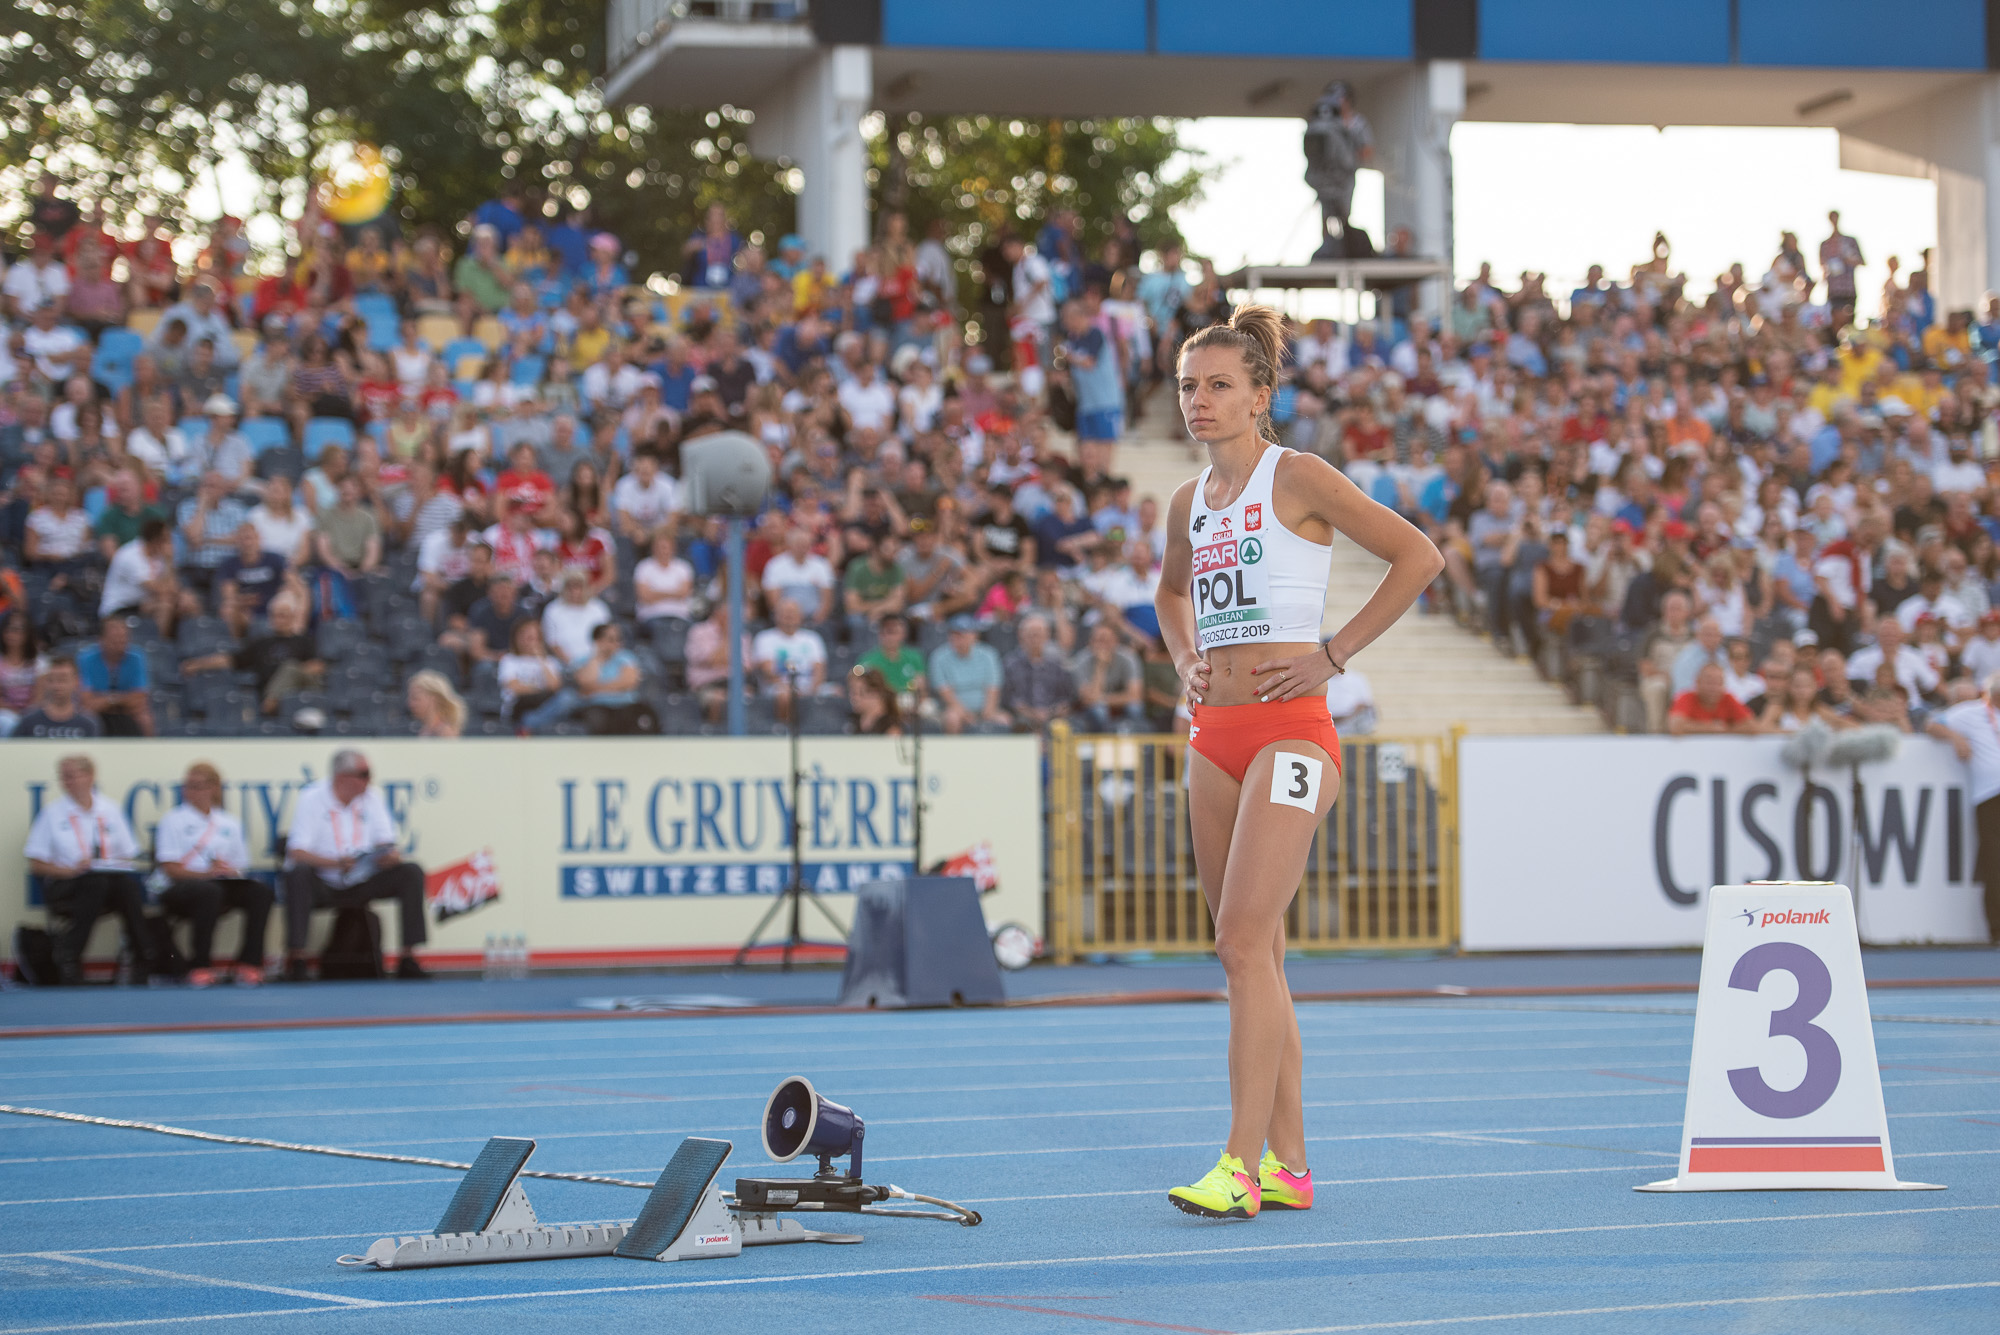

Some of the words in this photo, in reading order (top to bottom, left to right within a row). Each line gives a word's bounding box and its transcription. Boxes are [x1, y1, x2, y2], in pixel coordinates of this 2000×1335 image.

[1193, 515, 1207, 533] 4F
[1213, 531, 1232, 540] ORLEN
[1193, 544, 1237, 573] SPAR
[1198, 570, 1257, 615] POL
[1205, 615, 1217, 627] RUN
[1241, 624, 1270, 638] 2019
[1288, 761, 1309, 799] 3
[560, 778, 627, 854] LE
[573, 864, 905, 897] SWITZERAND
[1761, 908, 1831, 928] polanik
[1726, 941, 1842, 1119] 3
